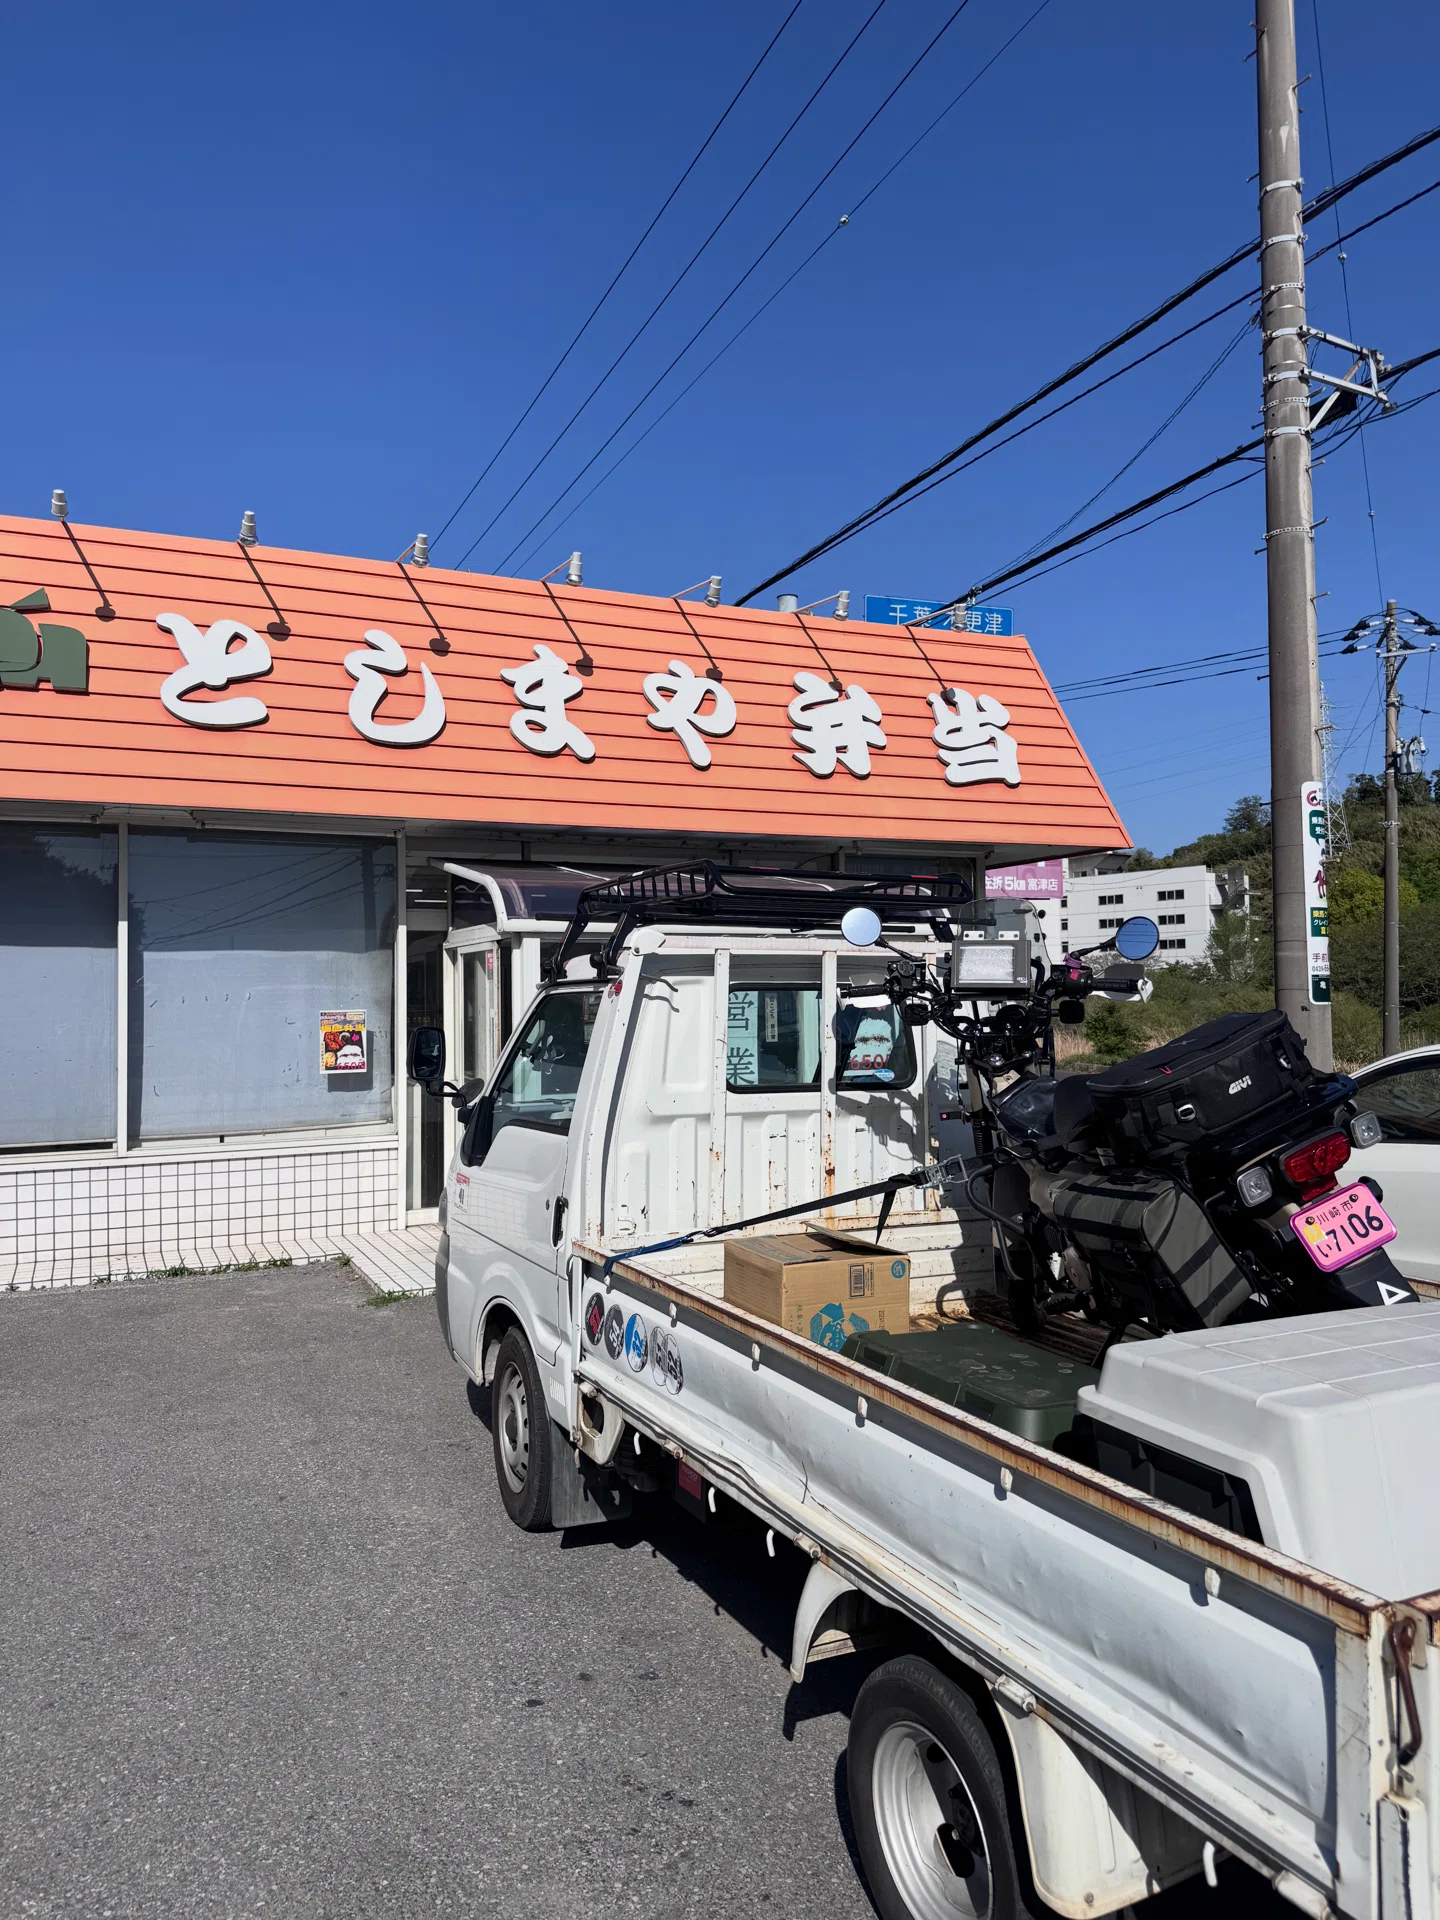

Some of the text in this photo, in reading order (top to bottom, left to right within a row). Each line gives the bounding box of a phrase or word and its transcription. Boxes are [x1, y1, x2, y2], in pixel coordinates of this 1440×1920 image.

[156, 612, 1022, 786] としまや弁当
[1004, 876, 1026, 891] 5km
[1027, 878, 1058, 891] 富津店
[849, 1053, 890, 1070] 650
[1228, 1075, 1252, 1095] GIVI
[1316, 1200, 1354, 1225] 川崎市
[1325, 1205, 1384, 1252] 7106
